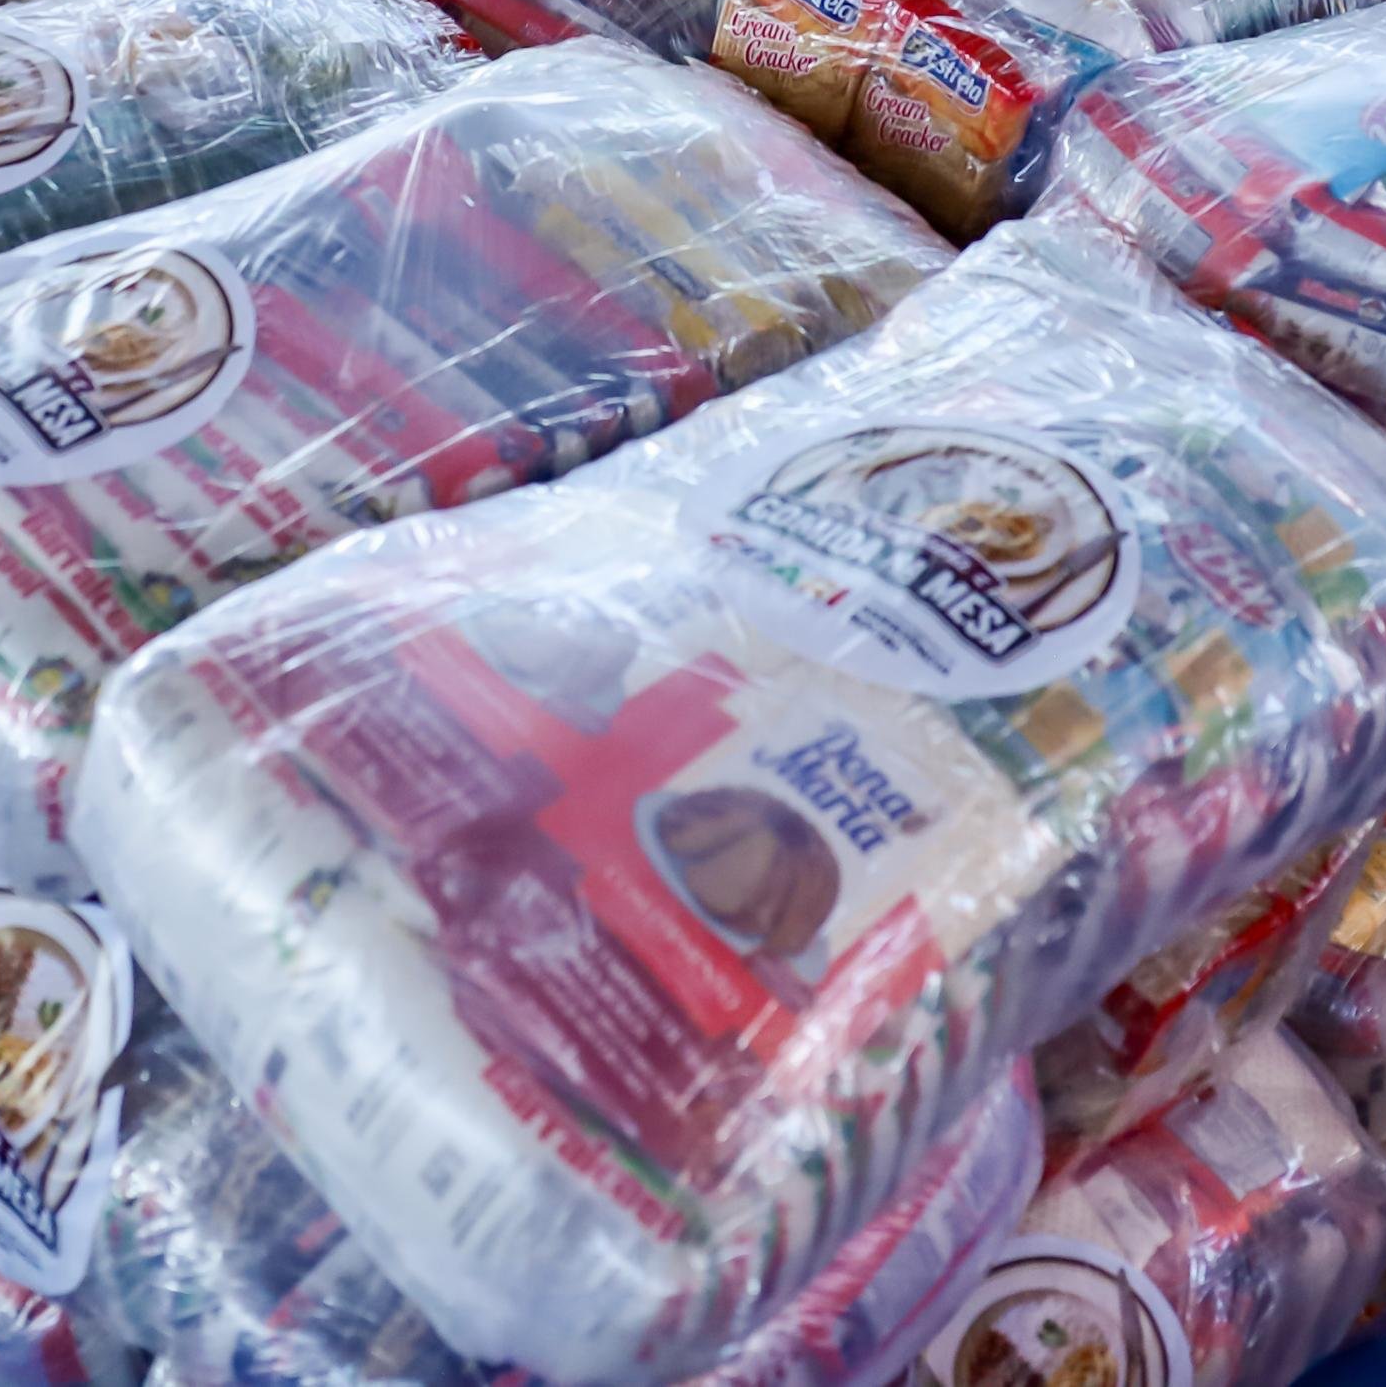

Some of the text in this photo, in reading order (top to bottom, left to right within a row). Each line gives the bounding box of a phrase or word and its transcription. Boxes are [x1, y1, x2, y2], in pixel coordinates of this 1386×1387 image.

[730, 10, 796, 43] Cream
[743, 38, 819, 76] Cracker
[864, 84, 931, 122] Cream
[877, 117, 951, 154] Cracker
[12, 373, 102, 449] MESA
[918, 570, 1026, 656] MESA
[751, 744, 885, 853] Maria
[785, 729, 913, 820] Dona
